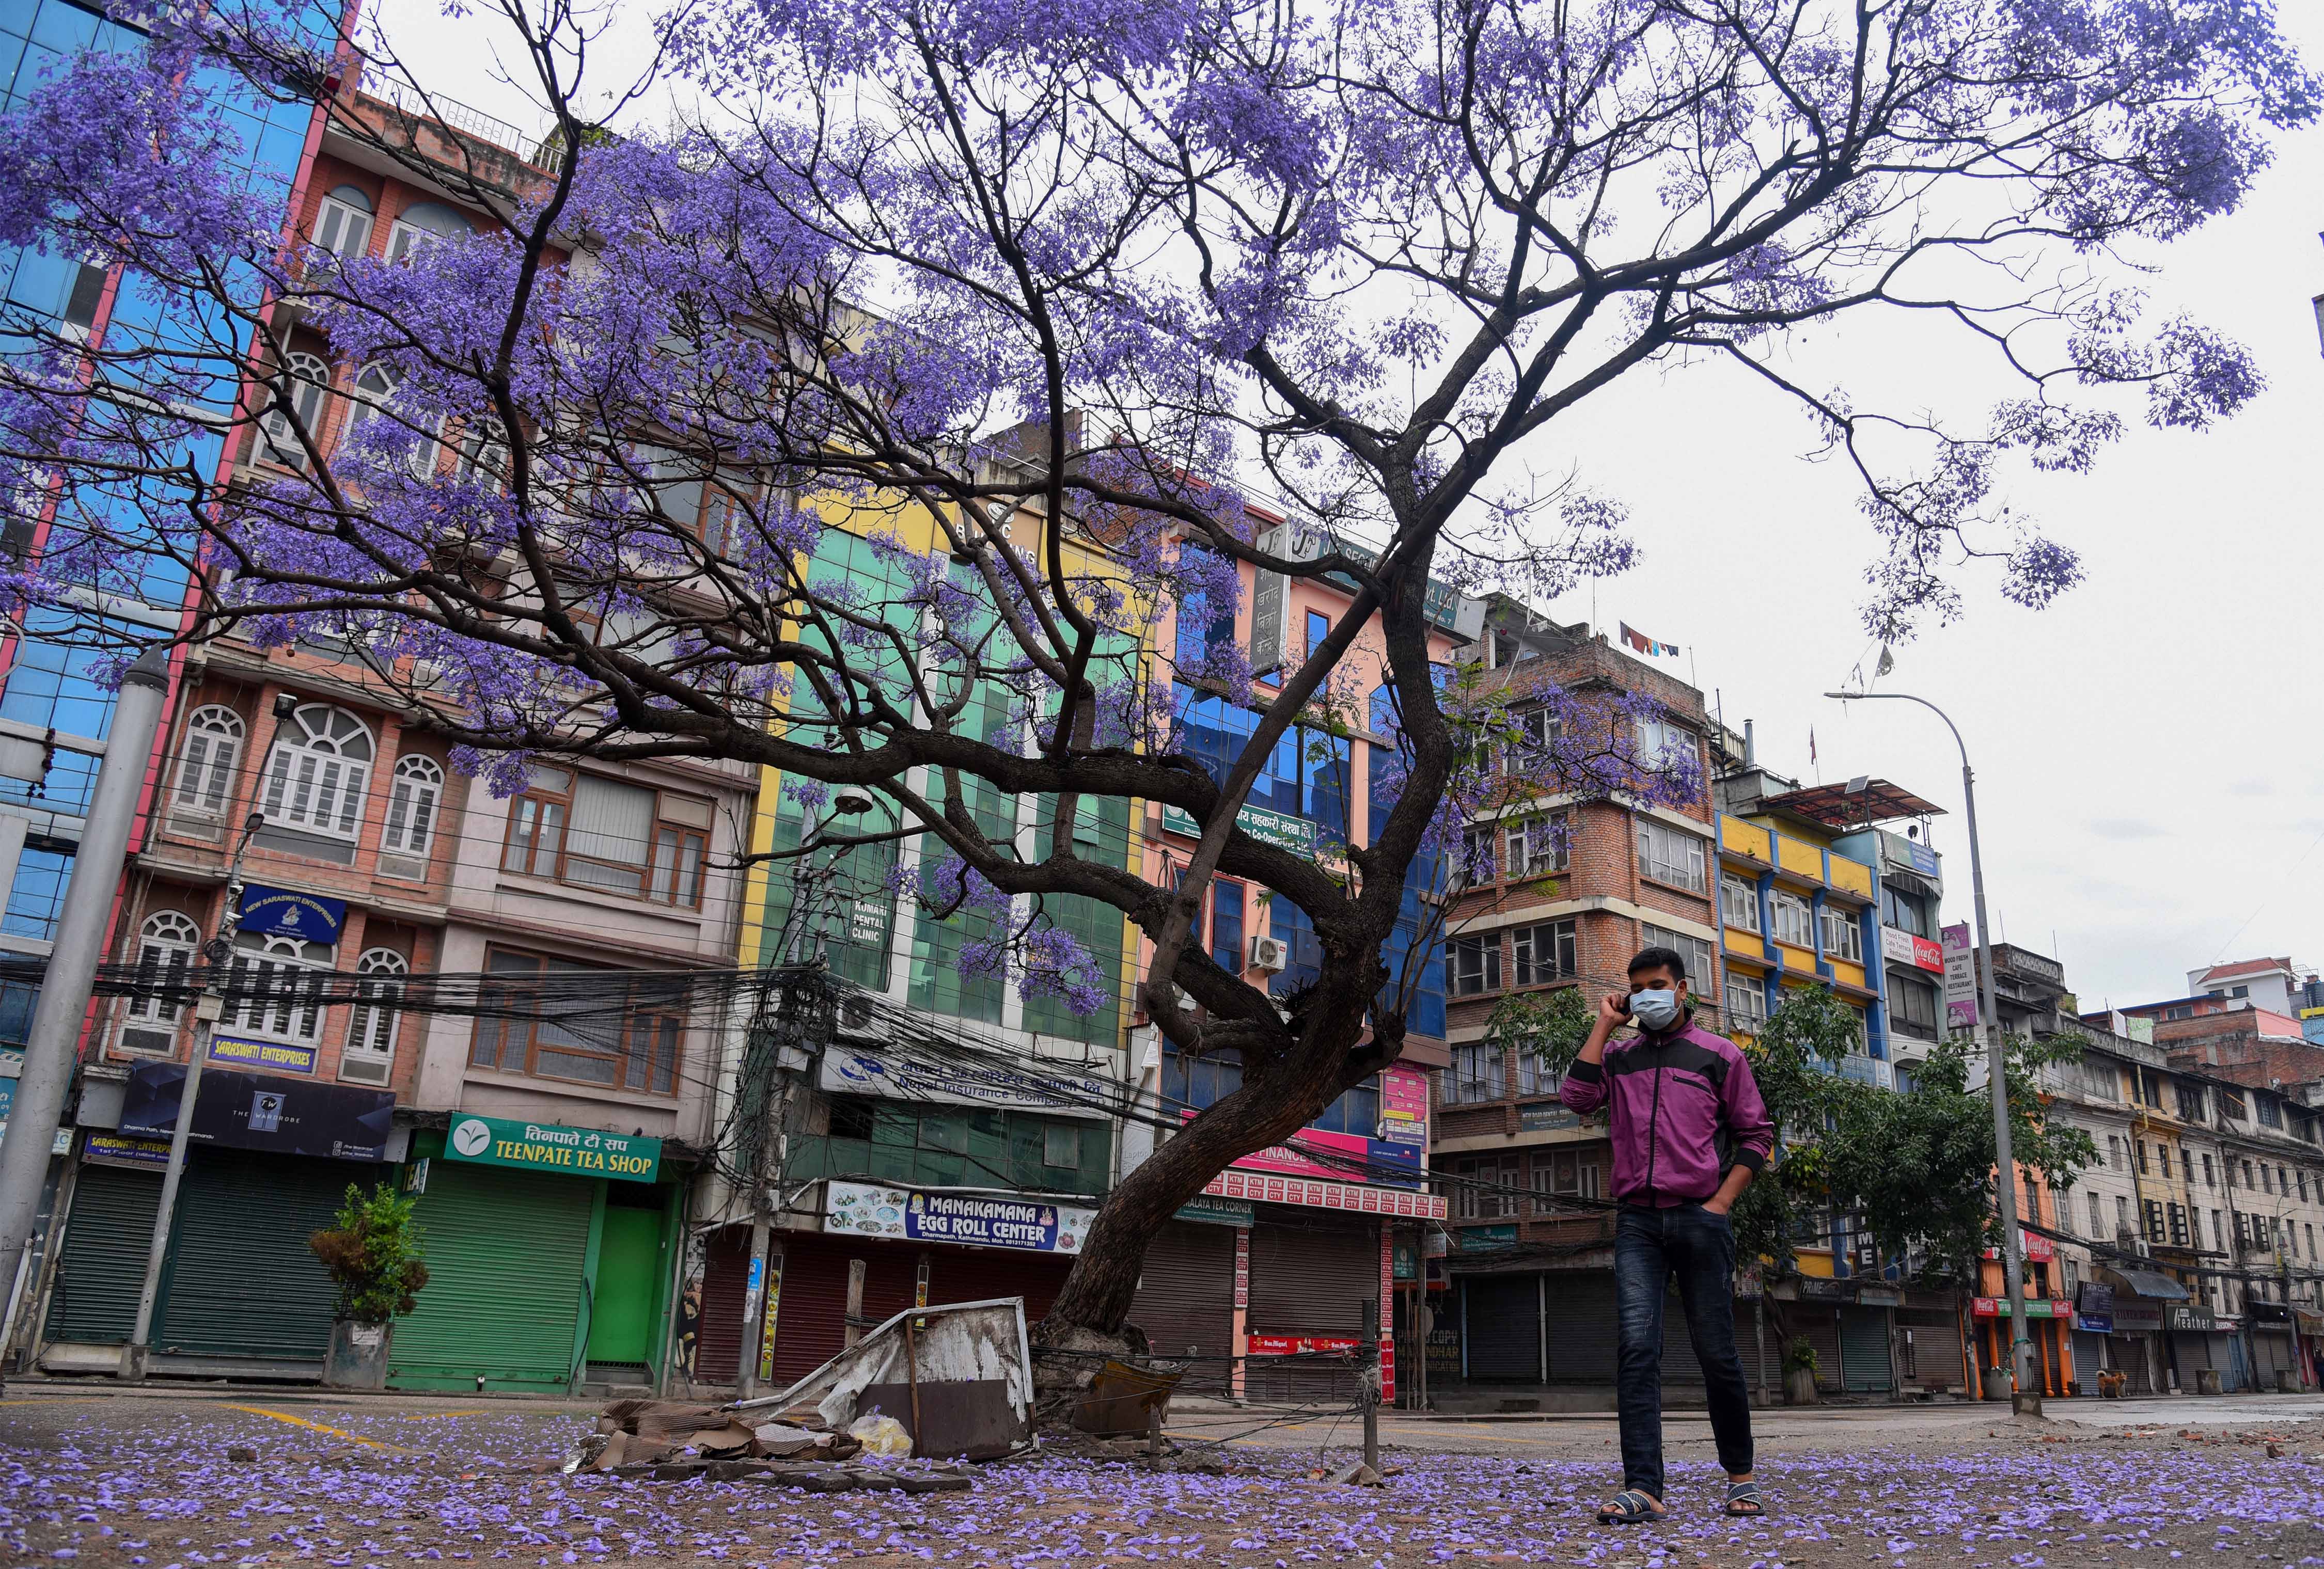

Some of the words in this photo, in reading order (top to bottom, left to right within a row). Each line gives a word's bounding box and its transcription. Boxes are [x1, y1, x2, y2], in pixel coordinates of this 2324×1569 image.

[1258, 584, 1280, 607] खरीद
[1251, 813, 1279, 830] सहकारी
[1281, 820, 1299, 835] संस्था
[245, 900, 262, 914] NEW
[262, 895, 301, 906] SARASWATI
[301, 898, 337, 928] ENTERPRISES
[854, 914, 884, 929] DENTAL
[852, 927, 880, 942] CLINIC
[1950, 972, 1967, 980] TERRACE
[1948, 980, 1972, 989] RESTAURANT
[215, 1040, 260, 1059] SARASWATI
[261, 1046, 310, 1066] ENTERPRISES
[944, 1080, 1009, 1099] Insurance
[255, 1113, 301, 1124] WARDROBE
[525, 1125, 581, 1146] तिनपाते
[584, 1134, 601, 1148] टी
[604, 1138, 629, 1151] सप
[496, 1140, 572, 1166] TEENPATE
[577, 1150, 604, 1169] TEA
[608, 1154, 652, 1175] SHOP
[1259, 1147, 1306, 1162] FINANCE
[930, 1197, 1036, 1223] MANAKAMANA
[1212, 1201, 1223, 1211] TEA
[1226, 1202, 1252, 1214] CORNER
[917, 1214, 947, 1232] EGG
[952, 1218, 988, 1237] ROLL
[993, 1222, 1045, 1243] CENTER
[922, 1231, 956, 1240] Dharmapath,
[2177, 1314, 2210, 1329] feather
[1432, 1329, 1458, 1344] COPY
